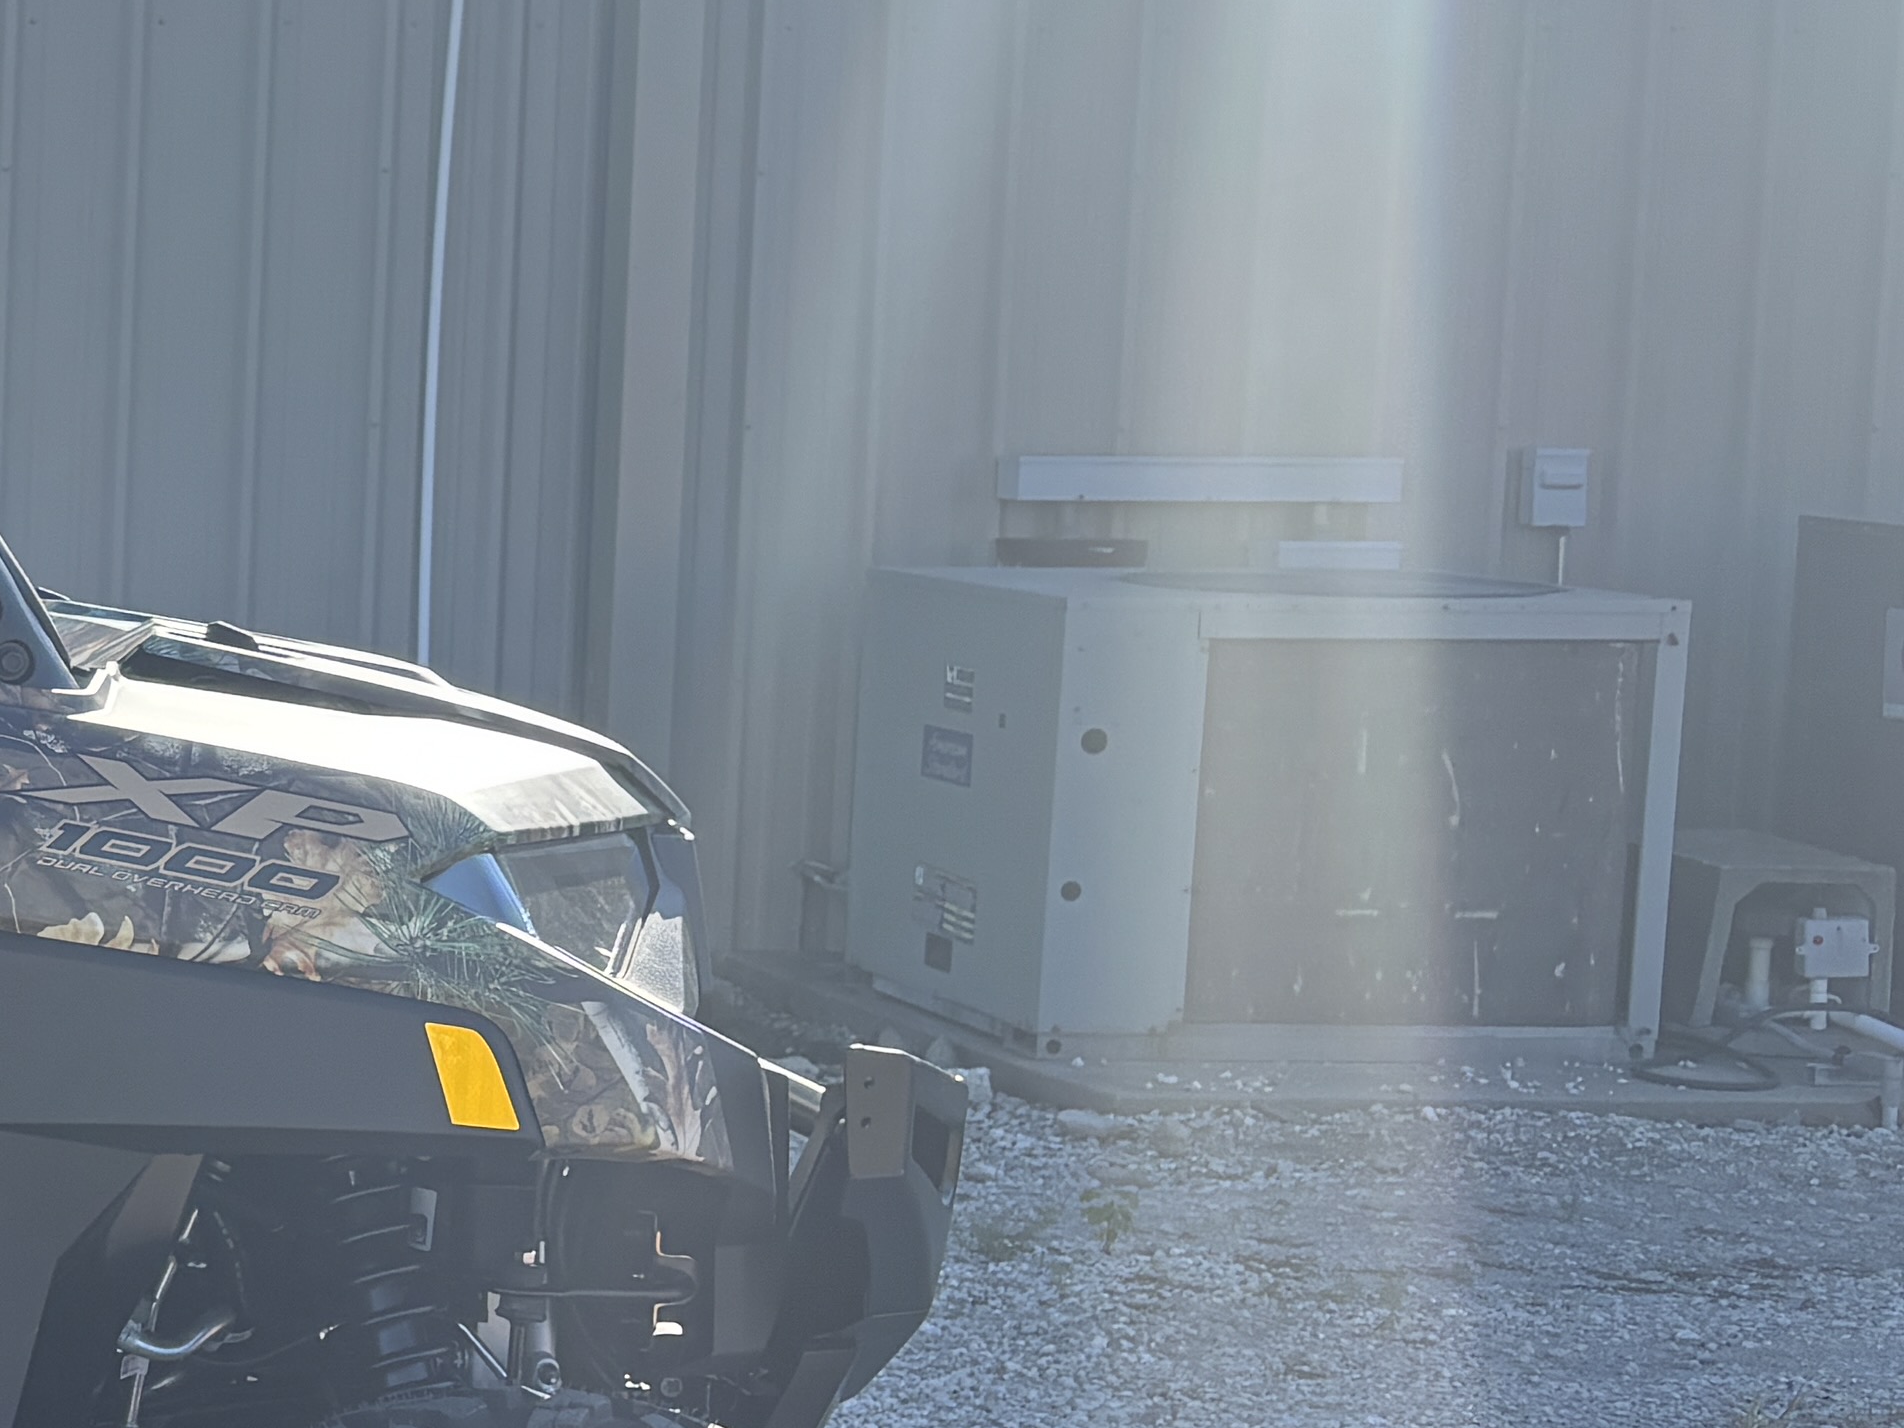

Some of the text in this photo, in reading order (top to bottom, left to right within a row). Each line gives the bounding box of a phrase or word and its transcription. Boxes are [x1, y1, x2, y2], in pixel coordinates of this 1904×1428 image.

[14, 752, 412, 842] XP
[36, 856, 323, 920] DUAL OVERHEAD CAM
[39, 818, 344, 902] 1000
